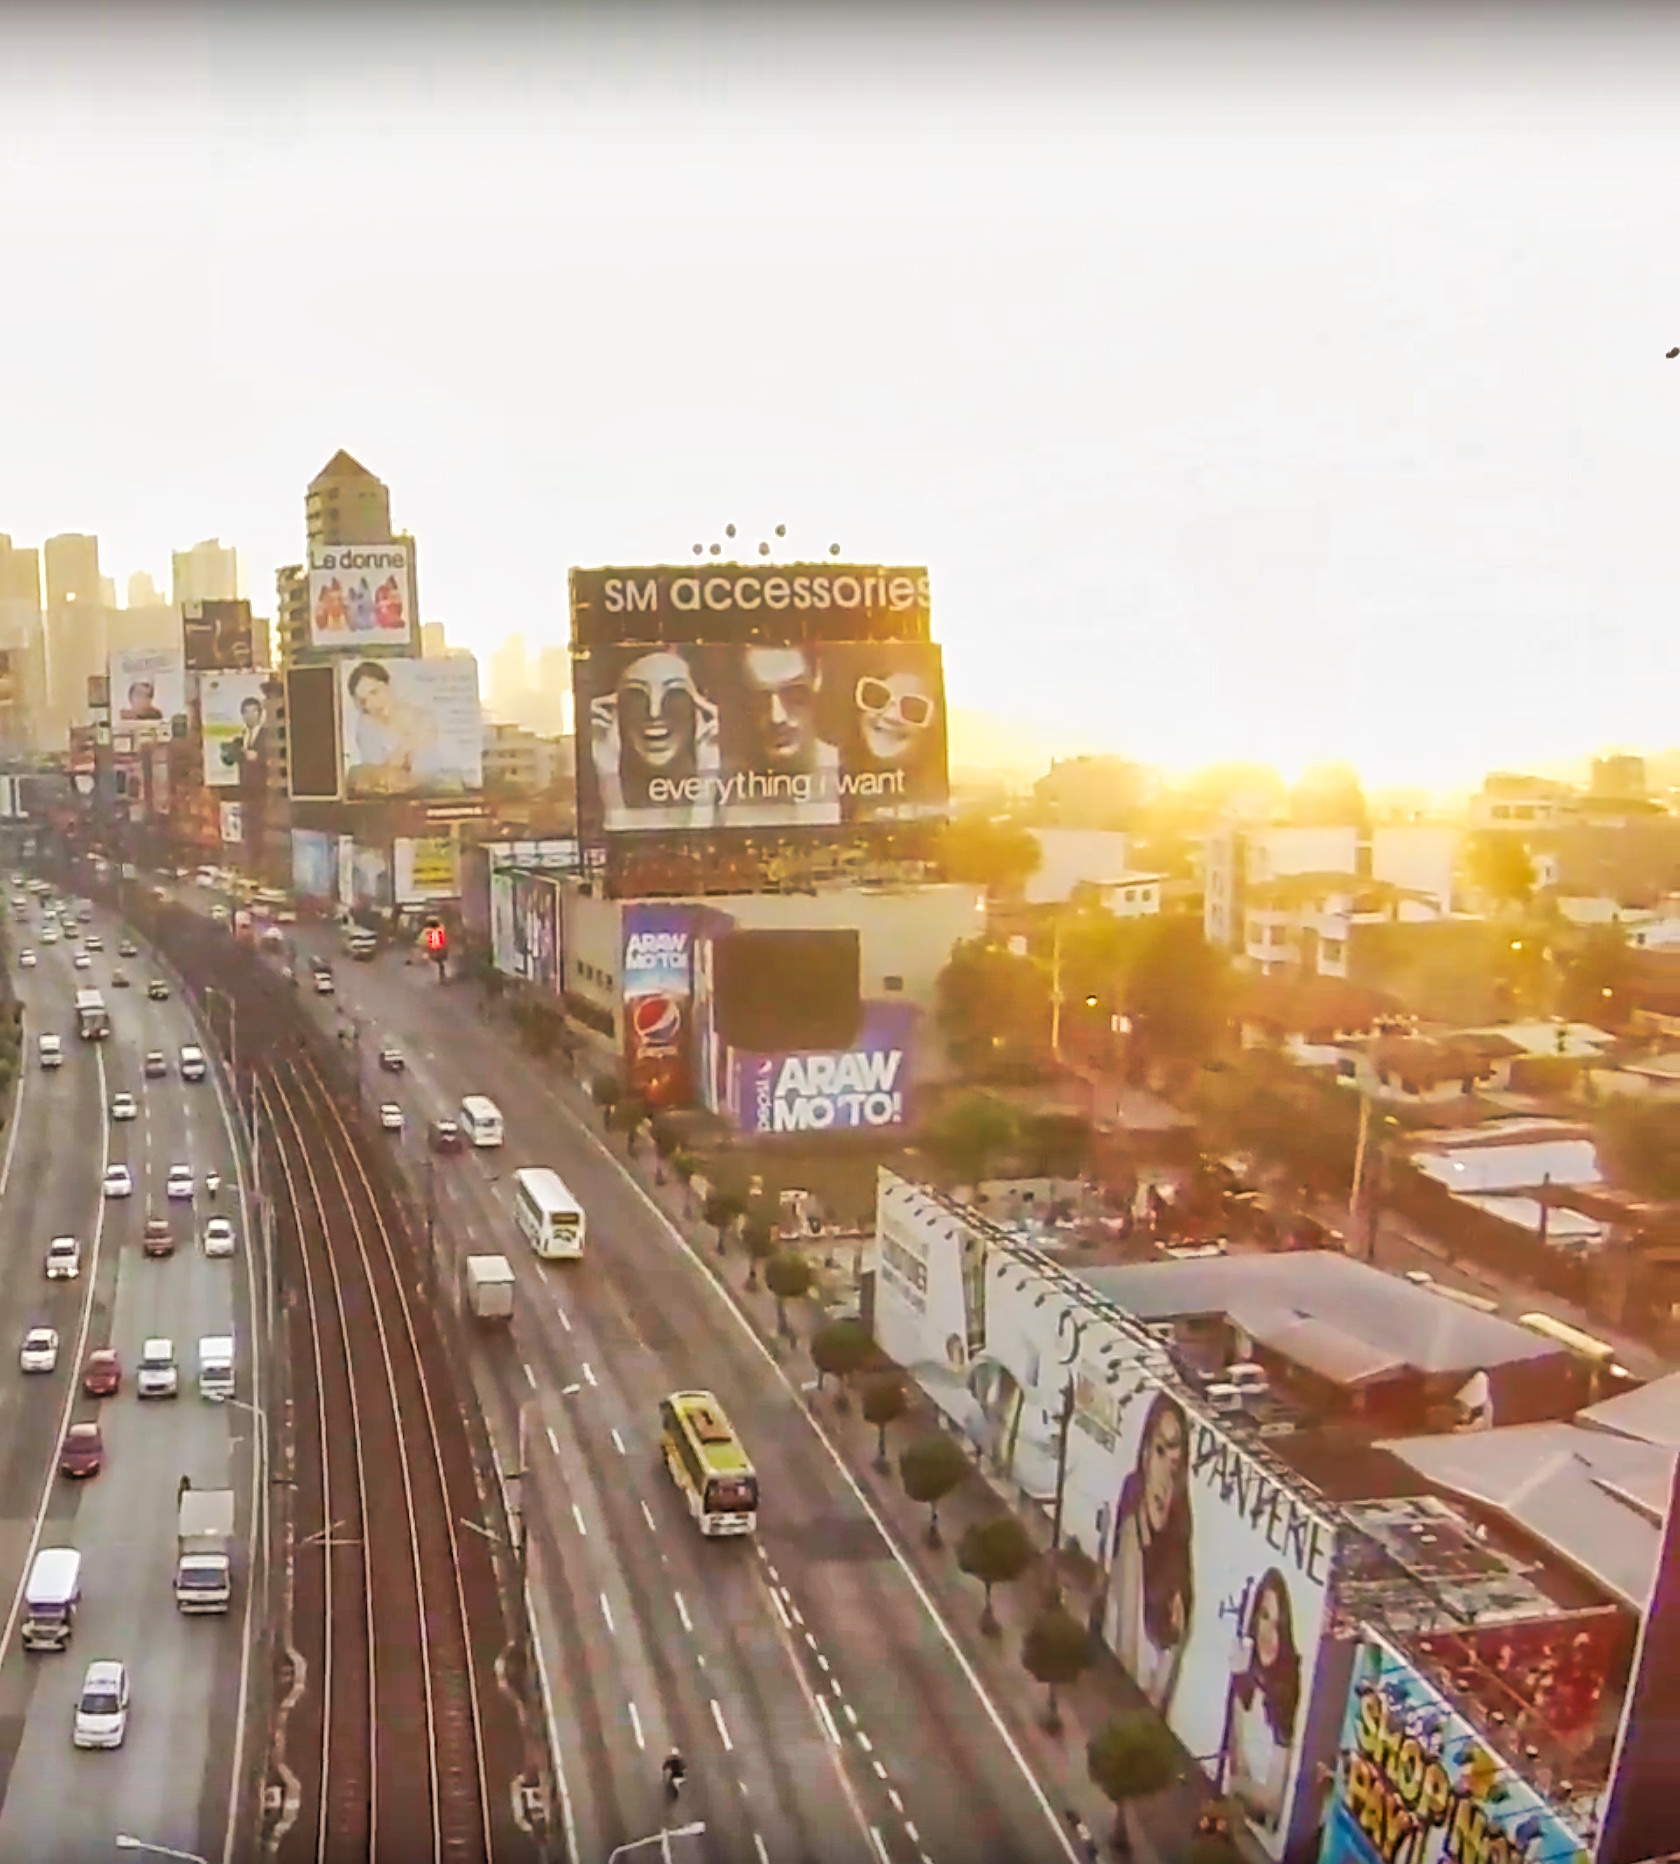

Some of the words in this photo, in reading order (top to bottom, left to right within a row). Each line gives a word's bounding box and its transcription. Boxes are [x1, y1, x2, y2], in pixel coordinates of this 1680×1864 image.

[340, 548, 405, 569] donne
[604, 578, 658, 612] SM
[670, 574, 930, 613] accessories
[648, 769, 811, 805] everything
[833, 767, 905, 796] want
[627, 932, 687, 952] ARAW
[775, 1050, 902, 1098] ARAW
[1192, 1425, 1324, 1586] PANTENE
